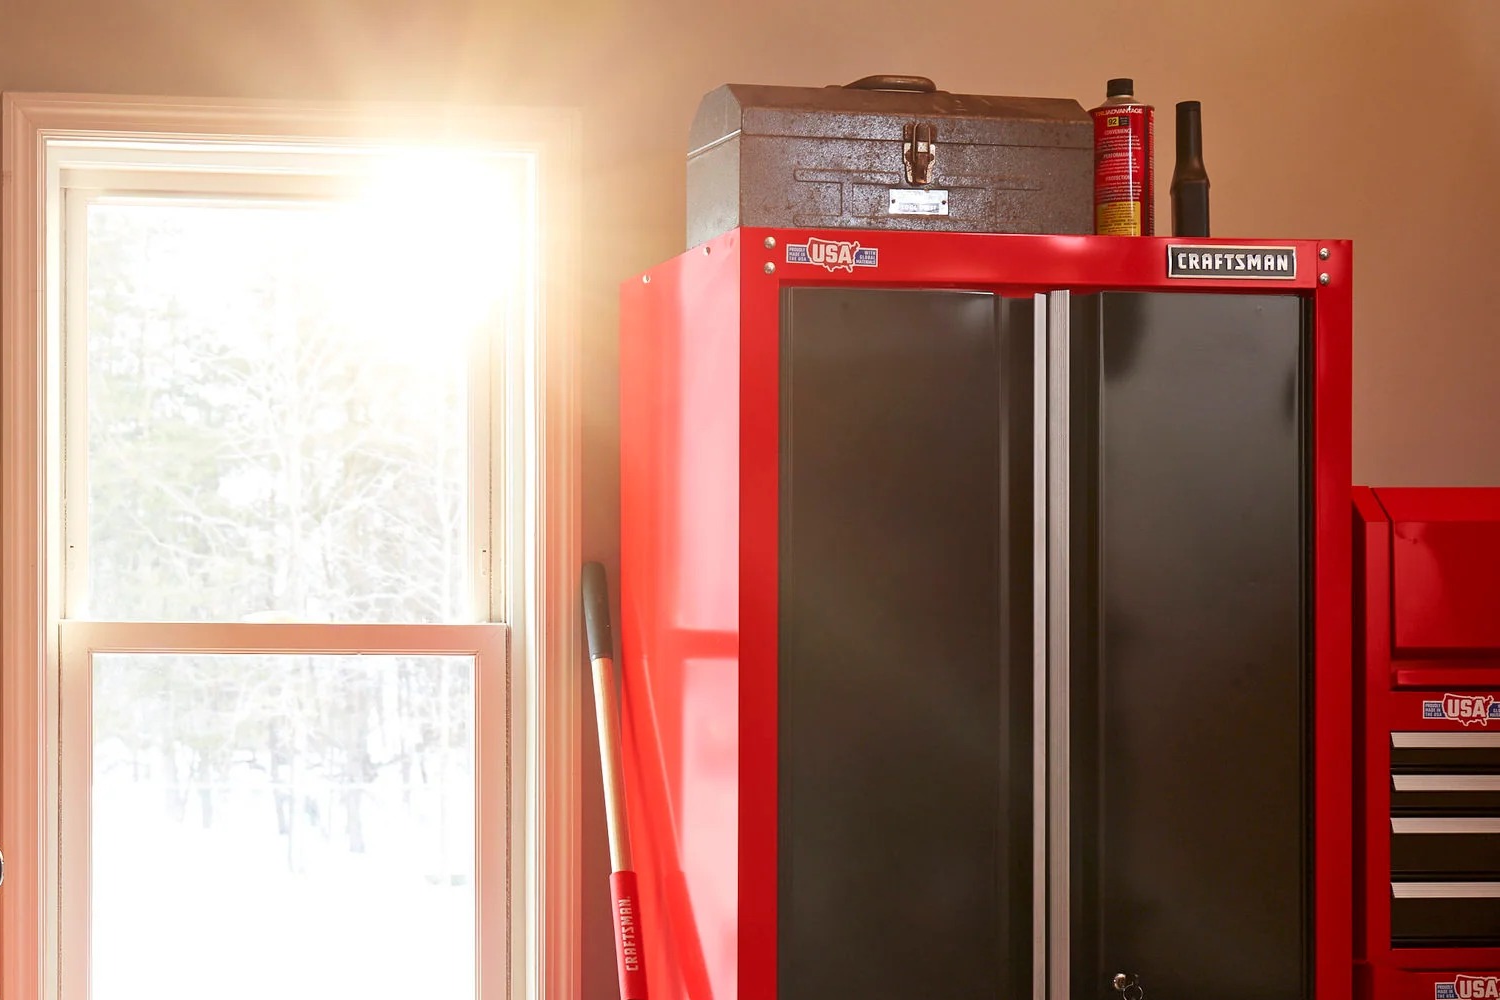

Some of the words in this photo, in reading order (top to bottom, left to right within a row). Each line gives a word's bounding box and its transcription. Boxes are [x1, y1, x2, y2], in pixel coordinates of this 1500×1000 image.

[812, 243, 853, 264] USA
[1177, 253, 1288, 271] CRAFTSMAN
[1447, 699, 1486, 717] USA
[618, 898, 639, 972] CRAFTSMAN
[1459, 980, 1499, 998] USA
